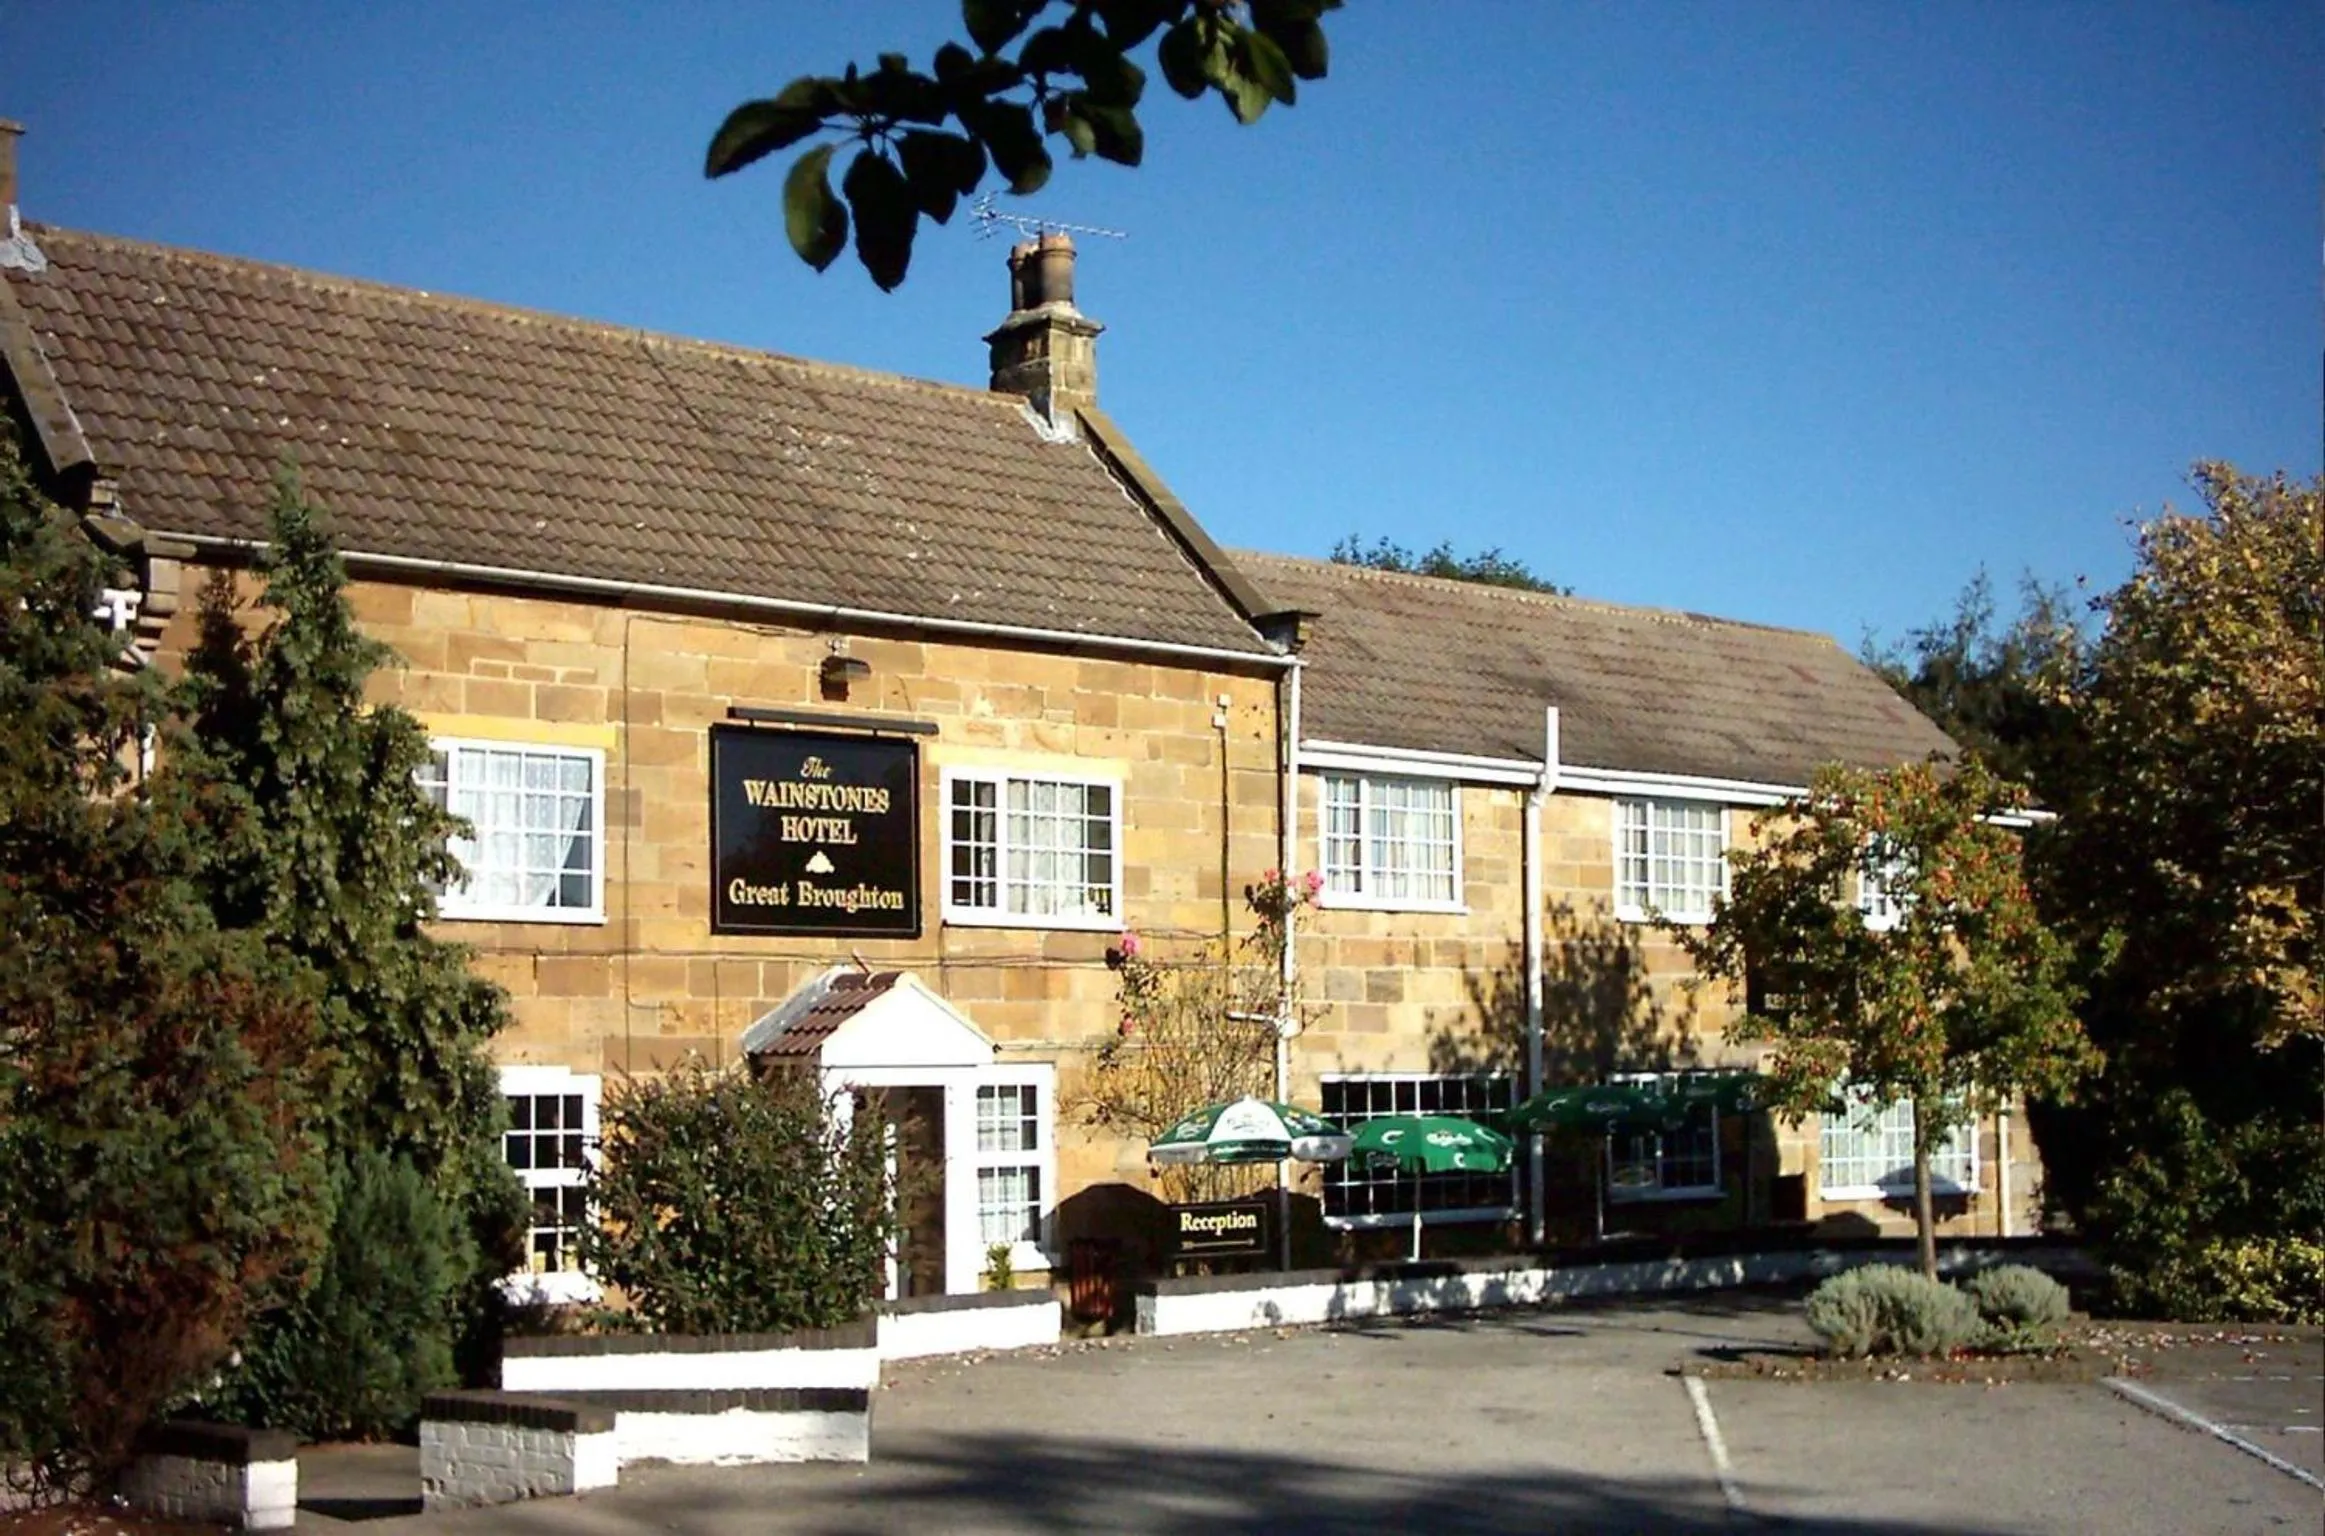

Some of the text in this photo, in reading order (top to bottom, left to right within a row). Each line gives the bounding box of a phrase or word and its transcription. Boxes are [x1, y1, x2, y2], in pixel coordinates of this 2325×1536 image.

[800, 756, 835, 779] The
[743, 780, 891, 814] WAINSTONES
[781, 816, 857, 844] HOTEL
[729, 878, 905, 913] Great Broughton
[1180, 1210, 1257, 1236] Reception
